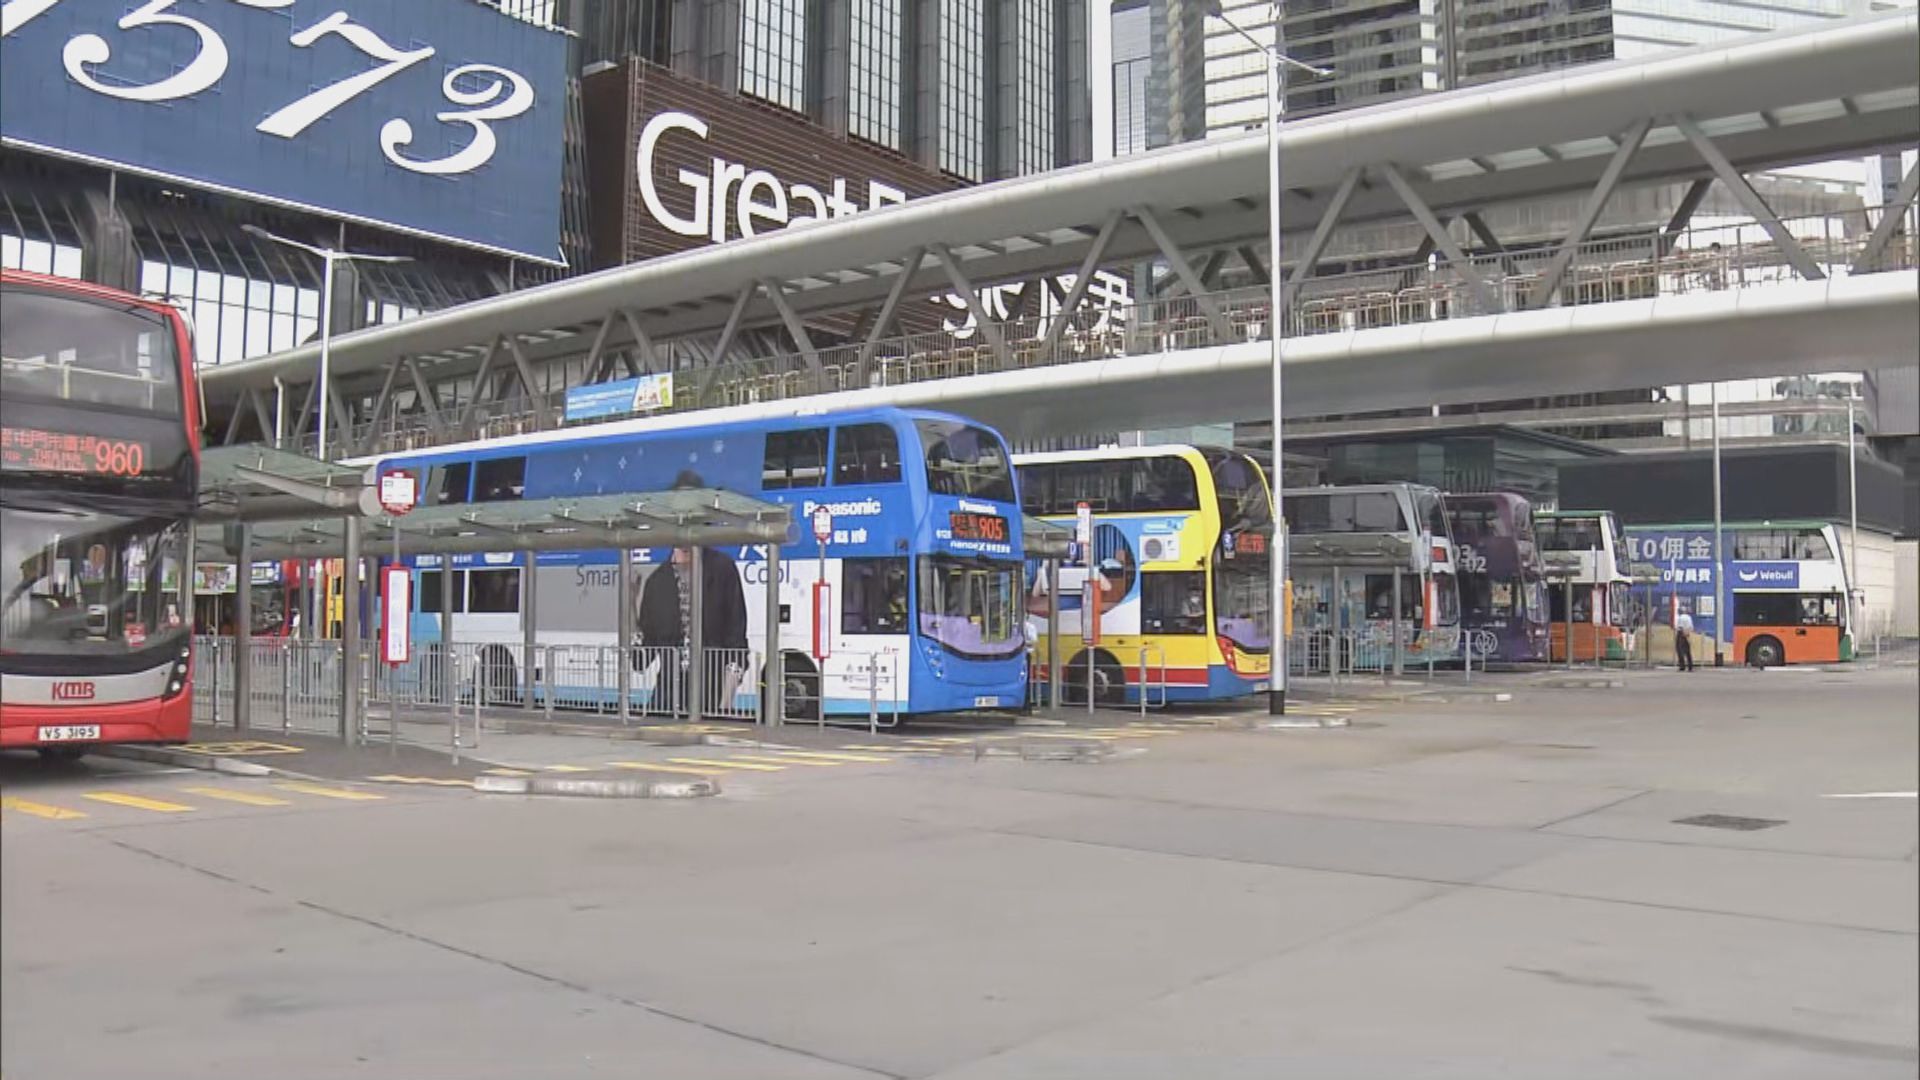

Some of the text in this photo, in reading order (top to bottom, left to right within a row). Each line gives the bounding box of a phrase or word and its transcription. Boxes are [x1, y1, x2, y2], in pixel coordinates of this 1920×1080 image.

[0, 0, 536, 174] 573
[95, 440, 143, 476] 960
[803, 497, 881, 518] Pasonic
[979, 517, 1003, 540] 905
[576, 565, 620, 587] Smar
[1759, 570, 1794, 581] Webull
[51, 681, 96, 700] KMB
[44, 725, 95, 739] VS 3195
